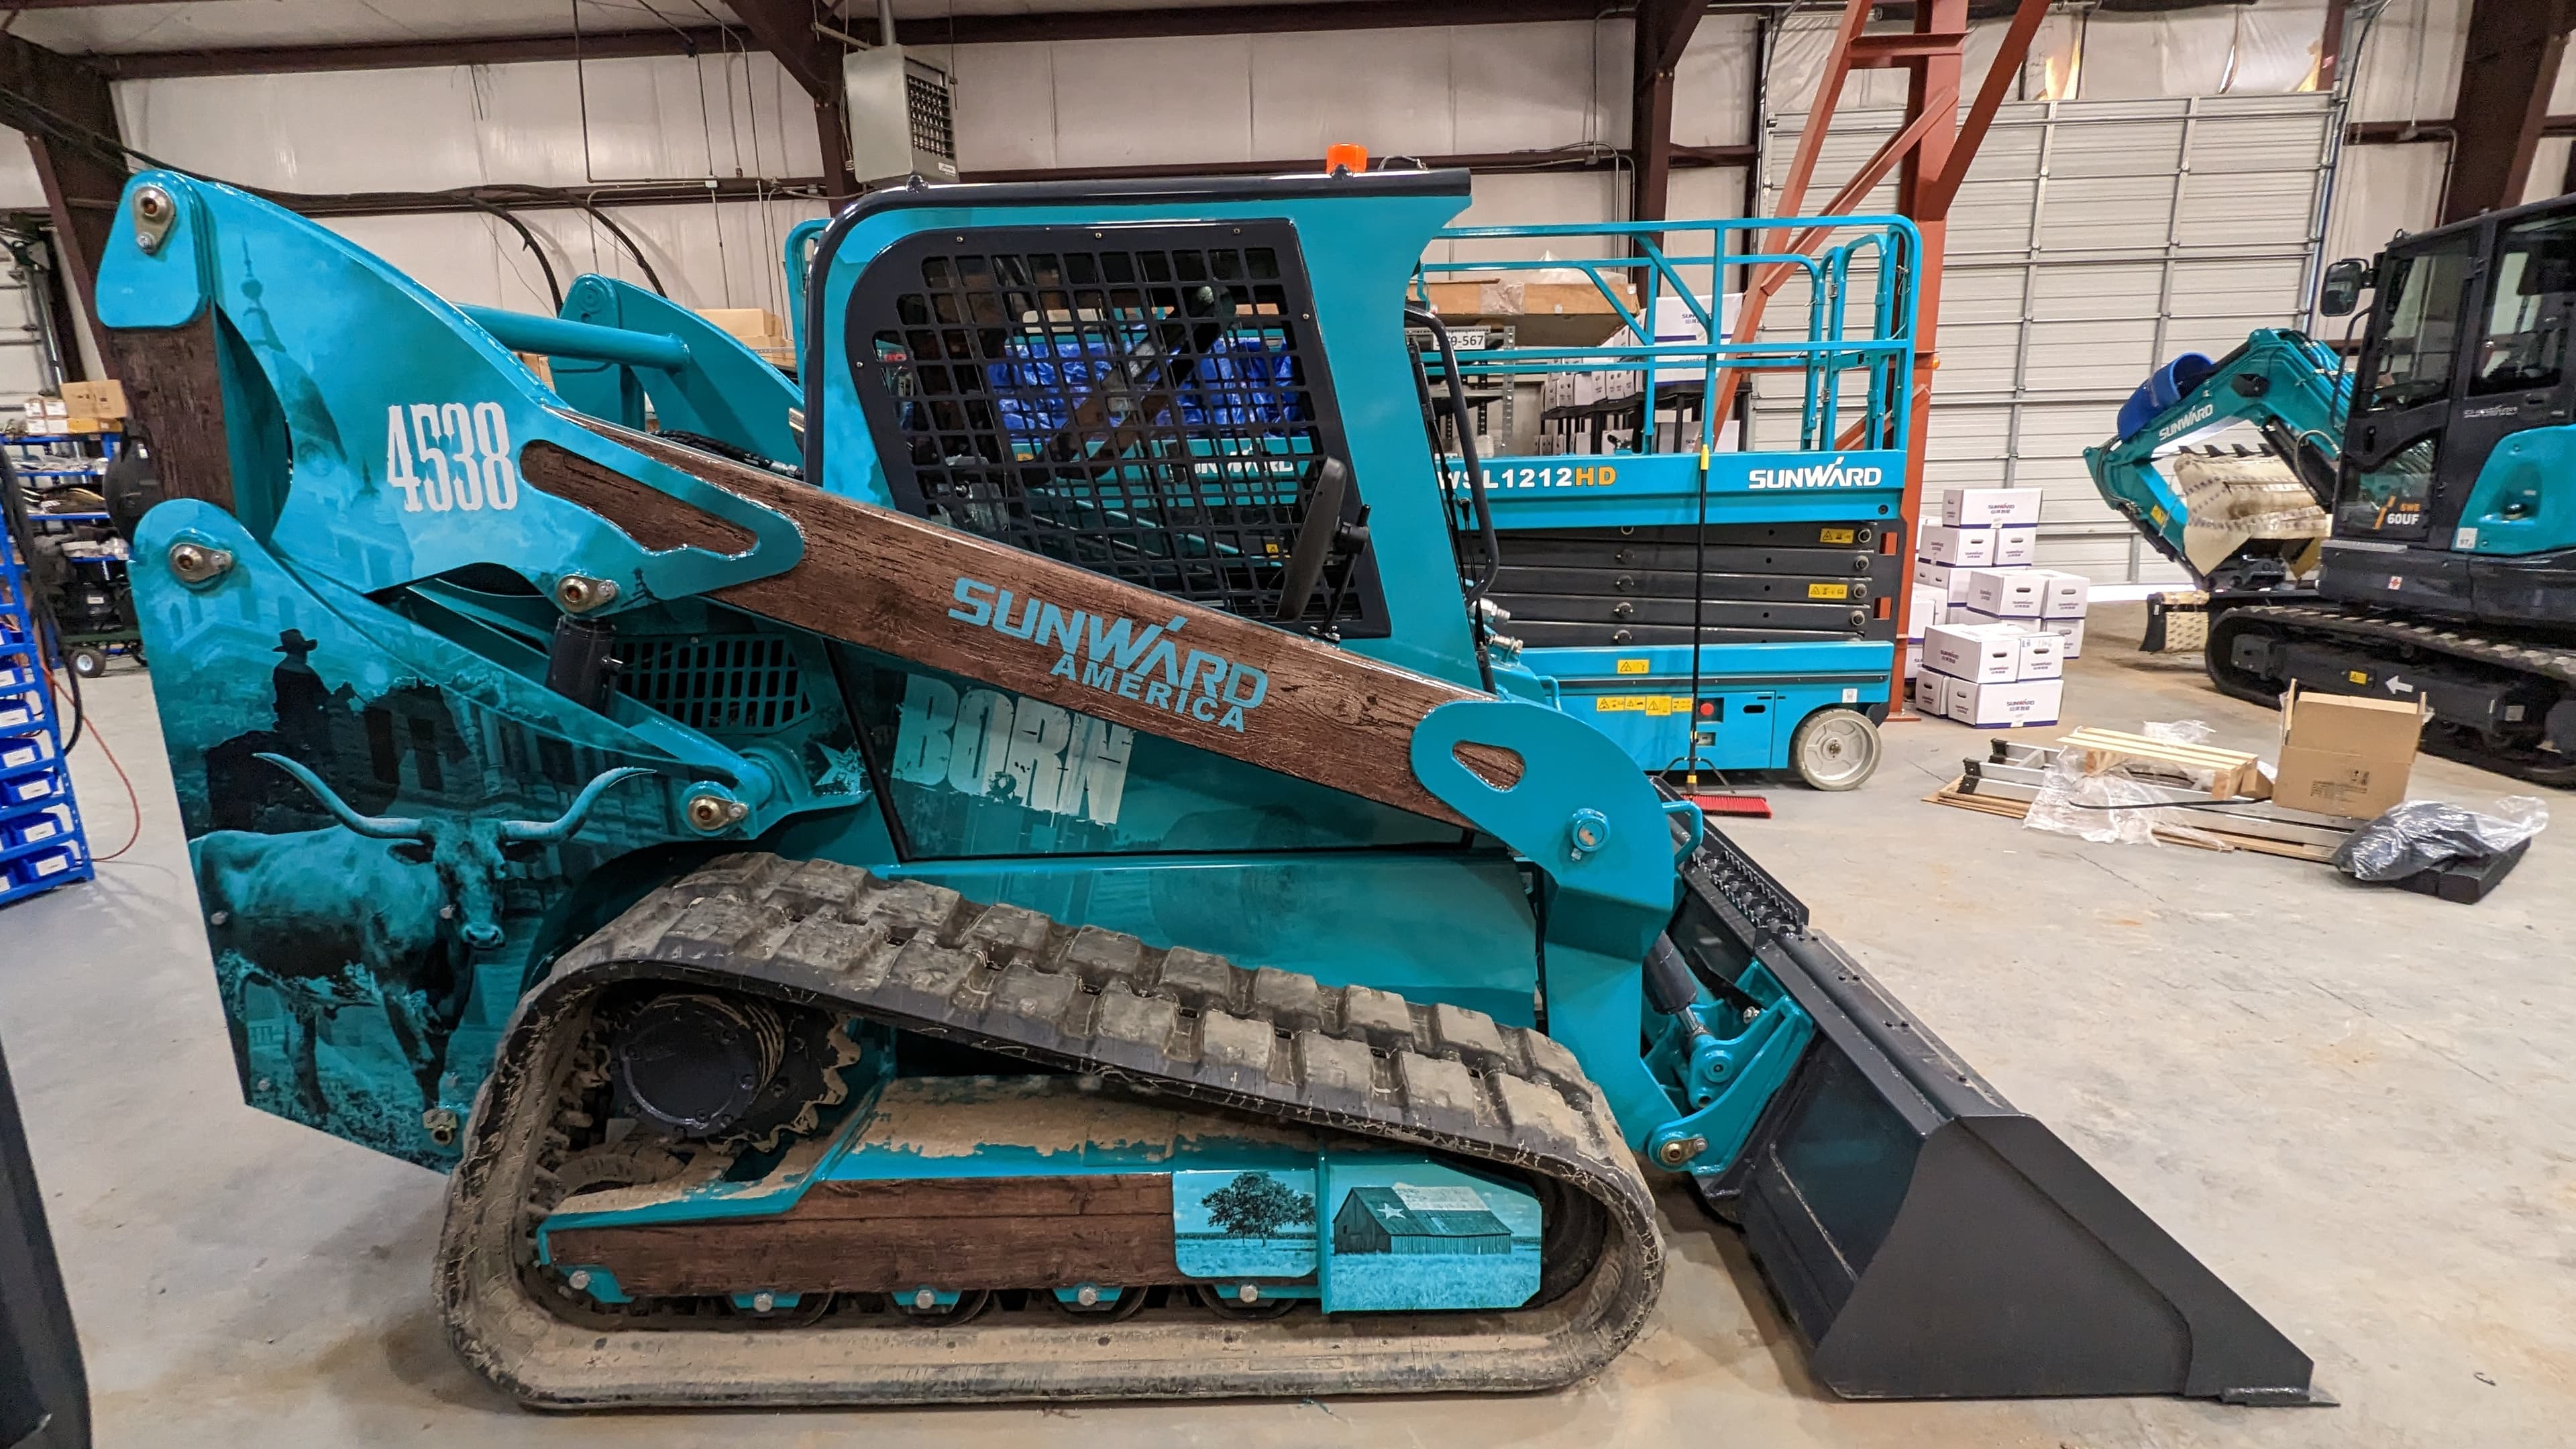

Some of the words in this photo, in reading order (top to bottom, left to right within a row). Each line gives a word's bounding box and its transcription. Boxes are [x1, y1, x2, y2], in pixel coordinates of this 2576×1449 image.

[1436, 335, 1484, 346] 9-567
[2159, 404, 2213, 441] SUNWARD
[387, 402, 518, 512] 4538
[1748, 456, 1882, 489] SUNWARD
[2387, 513, 2420, 525] 60UF
[948, 578, 1269, 708] SUNWARD
[1051, 653, 1245, 733] AMERICA
[891, 674, 1134, 826] BORN
